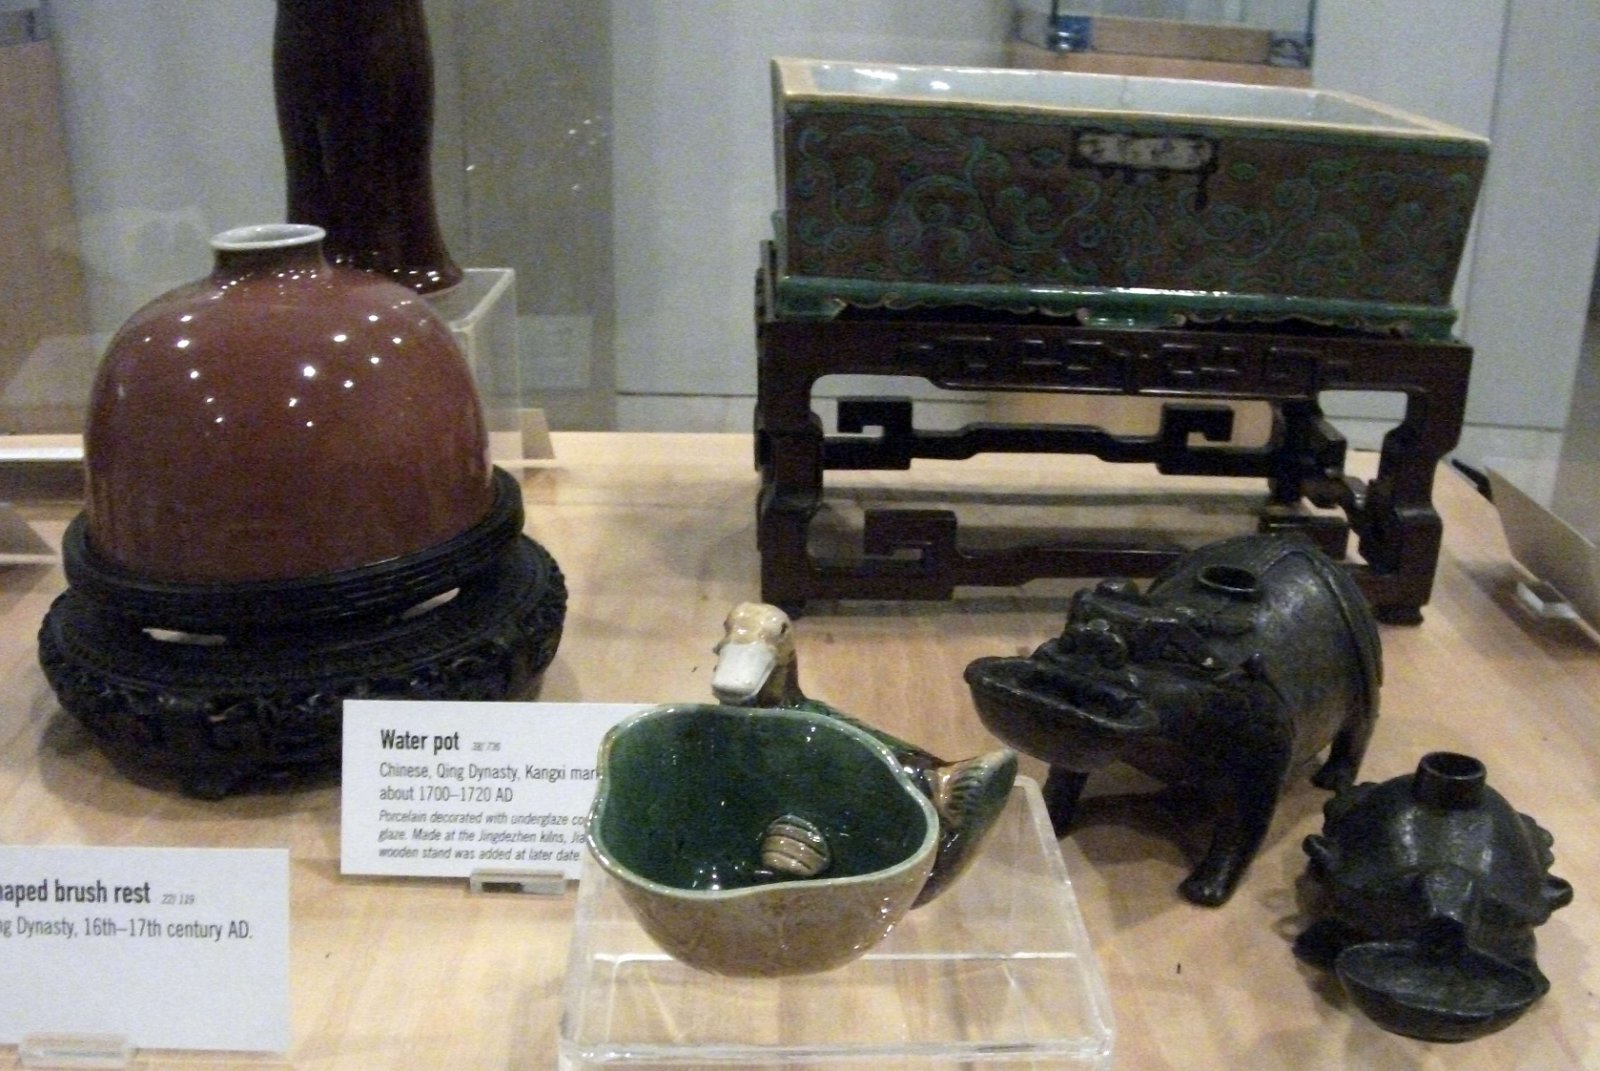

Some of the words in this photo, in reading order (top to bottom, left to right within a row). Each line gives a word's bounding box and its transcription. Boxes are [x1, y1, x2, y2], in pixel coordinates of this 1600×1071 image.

[381, 729, 428, 750] Water
[434, 731, 459, 755] pot
[379, 762, 432, 779] Chinese,
[437, 763, 464, 781] Qing
[469, 763, 520, 782] Dynasty,
[525, 765, 567, 783] Kangxi
[570, 767, 598, 781] mar
[379, 786, 415, 801] about
[495, 788, 513, 802] AD
[379, 809, 427, 823] Porcelain
[430, 811, 484, 824] decorated
[486, 812, 508, 824] with
[511, 812, 568, 828] underglaze
[412, 828, 441, 841] Made
[444, 829, 456, 841] at
[458, 829, 475, 842] the
[478, 829, 537, 844] Jingdezhen
[378, 845, 419, 858] wooden
[422, 846, 452, 859] stand
[454, 849, 475, 860] was
[478, 847, 513, 860] added
[515, 848, 526, 861] at
[529, 848, 553, 861] later
[55, 879, 108, 904] brush
[114, 881, 150, 904] rest
[17, 916, 78, 939] Dynasty,
[167, 920, 223, 943] century
[227, 920, 253, 940] AD.
